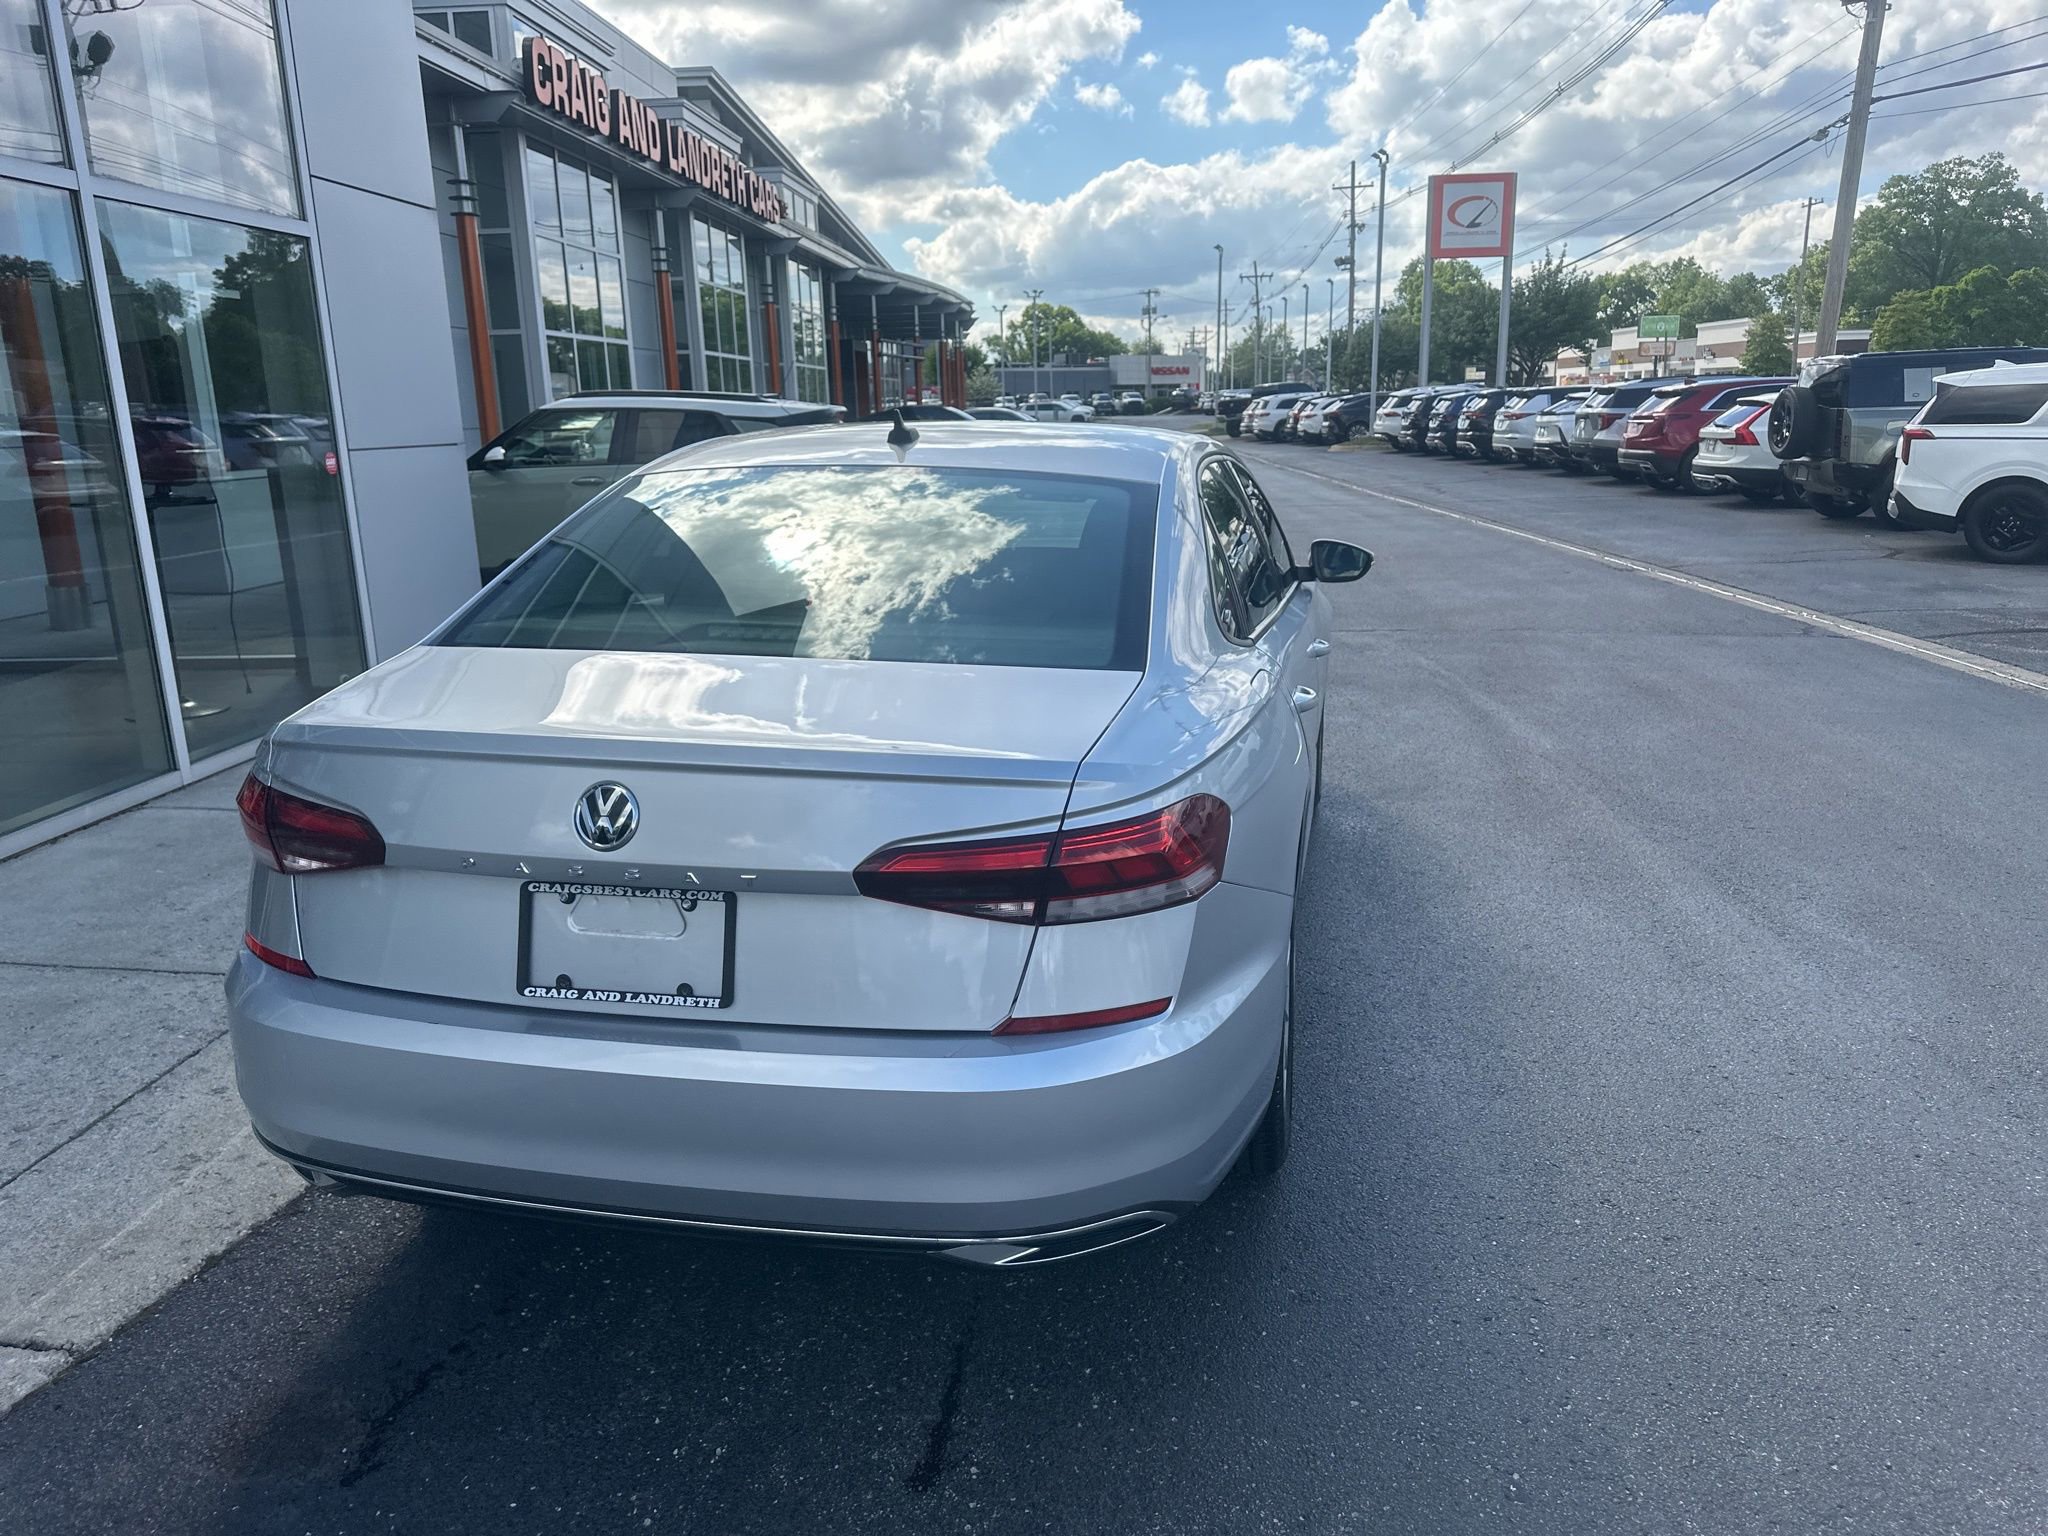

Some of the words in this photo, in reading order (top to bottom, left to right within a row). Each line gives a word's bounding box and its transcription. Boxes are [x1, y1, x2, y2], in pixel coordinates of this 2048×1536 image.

[529, 35, 610, 137] CRAIG
[617, 88, 661, 163] AND
[665, 118, 748, 208] LANDRETH
[749, 168, 782, 225] CARS
[1151, 366, 1191, 377] NISSAN
[524, 986, 579, 1000] CRAIG
[582, 990, 621, 1003] AND
[624, 993, 721, 1009] LANDRETH
